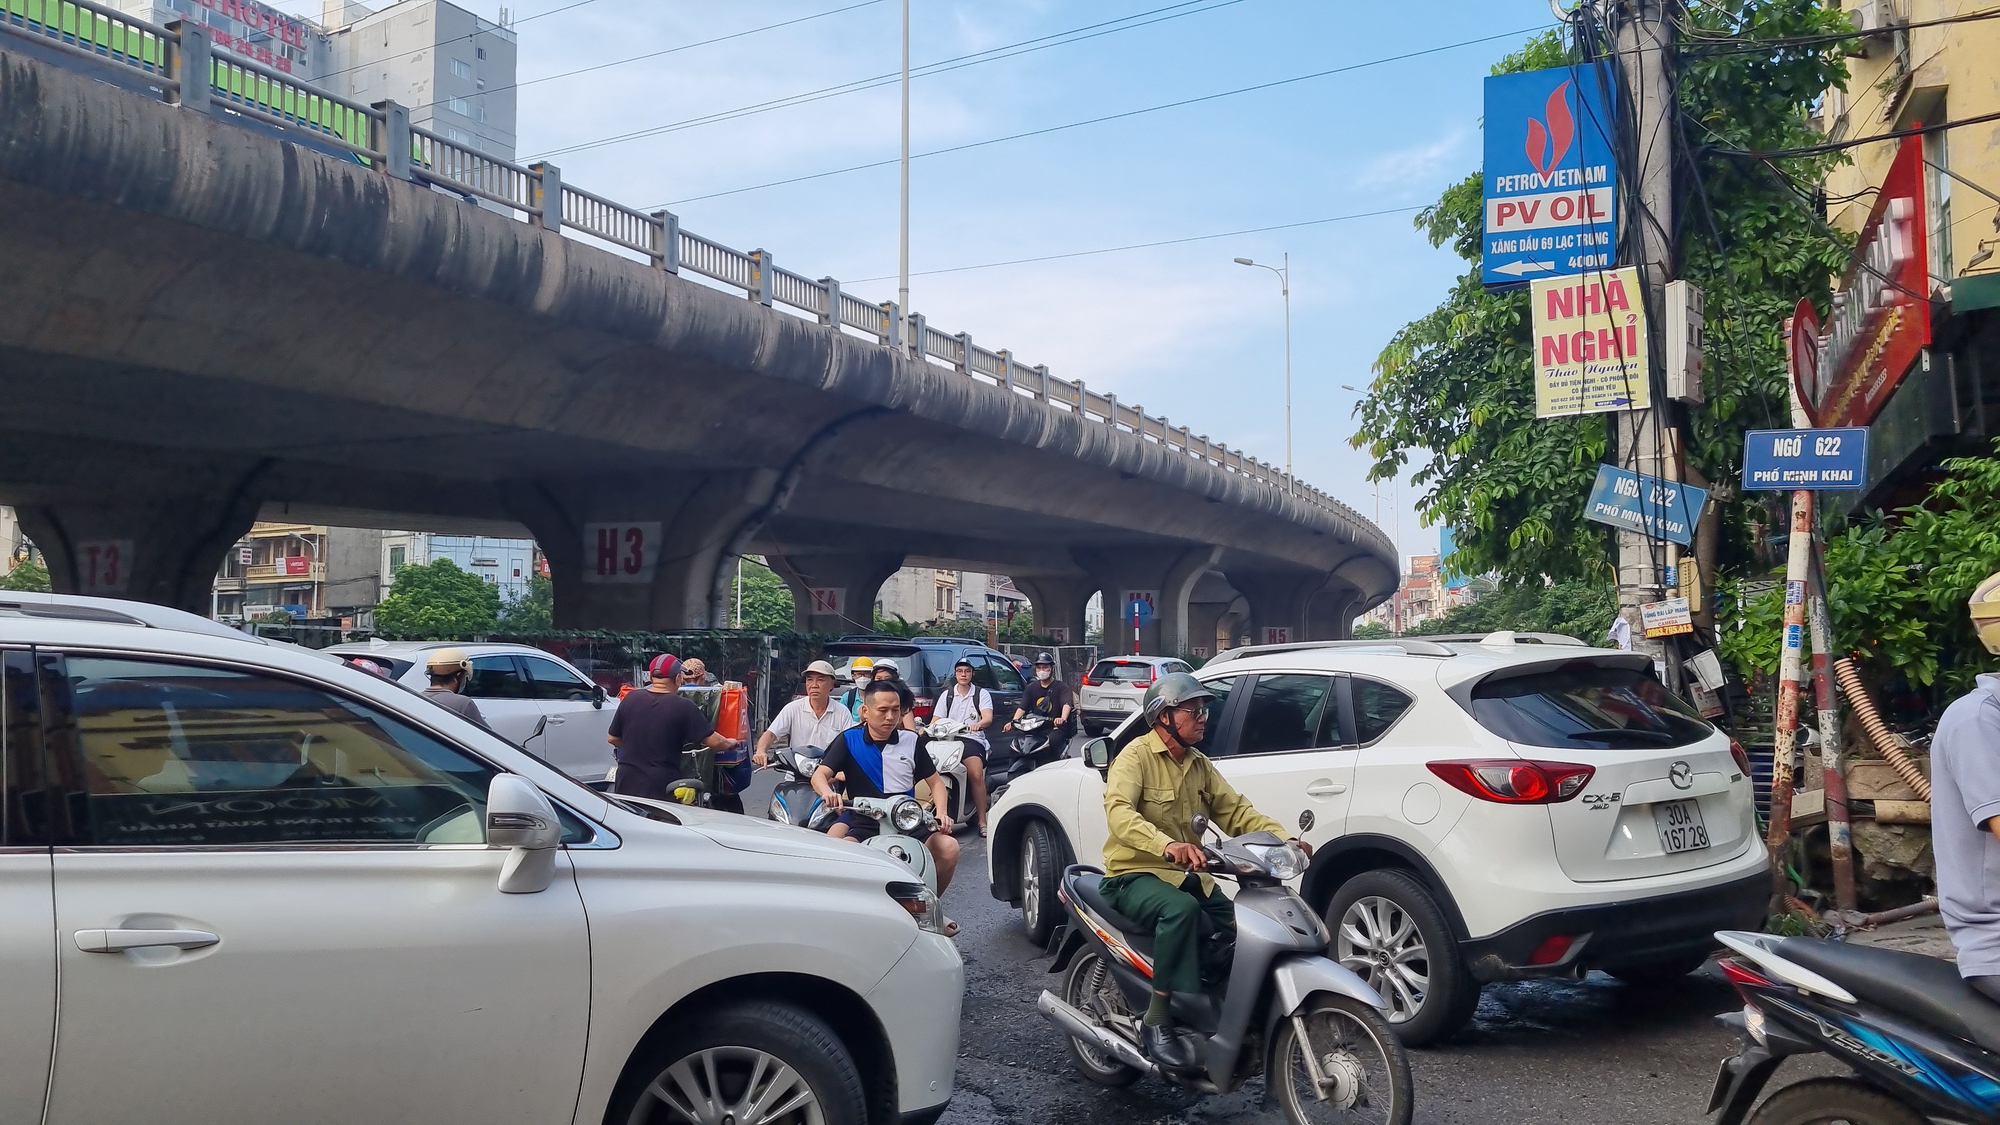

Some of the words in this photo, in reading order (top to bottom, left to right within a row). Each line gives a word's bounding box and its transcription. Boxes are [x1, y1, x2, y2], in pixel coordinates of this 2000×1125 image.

[220, 0, 307, 50] HOTEL
[237, 40, 254, 57] 25
[256, 48, 273, 67] 25
[275, 55, 292, 74] 25
[1496, 165, 1607, 193] PETROVIETNAM
[1497, 199, 1541, 227] PV
[1550, 194, 1606, 221] OIL
[1491, 238, 1517, 254] XĂNG
[1519, 235, 1539, 252] DẦU
[1541, 237, 1553, 250] 69
[1555, 235, 1574, 250] LẠC
[1576, 232, 1609, 248] TRUNG
[1568, 253, 1608, 269] 400M
[1546, 273, 1630, 320] NHÀ
[1541, 313, 1638, 367] NGHỈ
[1773, 434, 1802, 457] NGÕ
[1815, 436, 1841, 456] 622
[1753, 467, 1780, 482] PHỐ
[1783, 470, 1818, 482] MINH
[1821, 470, 1853, 481] KHAI
[1613, 476, 1644, 498] NGÕ
[1649, 485, 1677, 508] 622
[1595, 502, 1621, 517] PHỐ
[1621, 509, 1653, 526] MINH
[1656, 517, 1684, 534] KHAI
[597, 527, 643, 576] H3
[84, 544, 119, 588] T3
[815, 590, 837, 612] T4
[1268, 628, 1287, 645] H5
[1581, 792, 1621, 804] CX-5
[1665, 803, 1692, 827] 30A
[1663, 825, 1708, 852] 167.28
